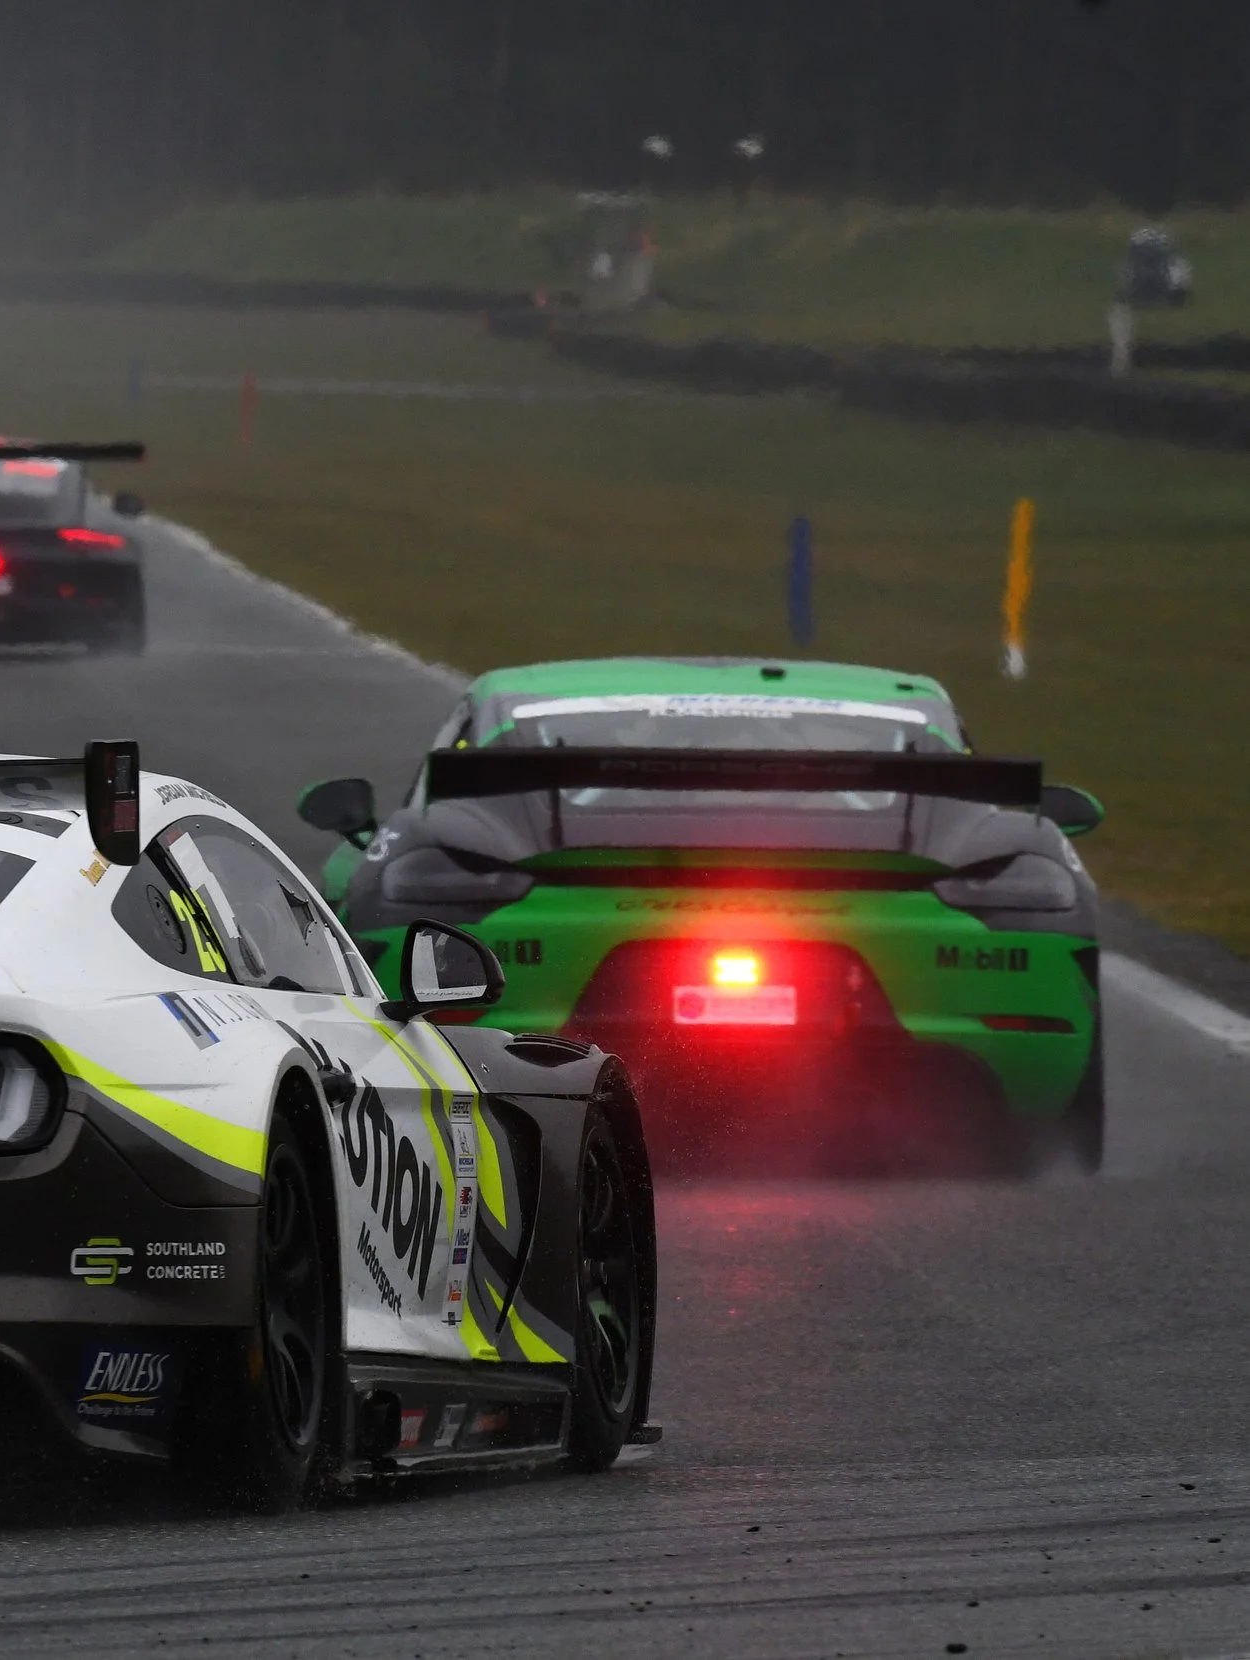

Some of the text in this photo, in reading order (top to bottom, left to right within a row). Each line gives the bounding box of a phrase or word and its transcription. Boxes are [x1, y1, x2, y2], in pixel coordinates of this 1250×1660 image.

[146, 1242, 226, 1256] SOUTHLAND
[146, 1265, 219, 1279] CONCRETE
[357, 1220, 402, 1320] Motorsport
[84, 1351, 170, 1392] ENDLESS
